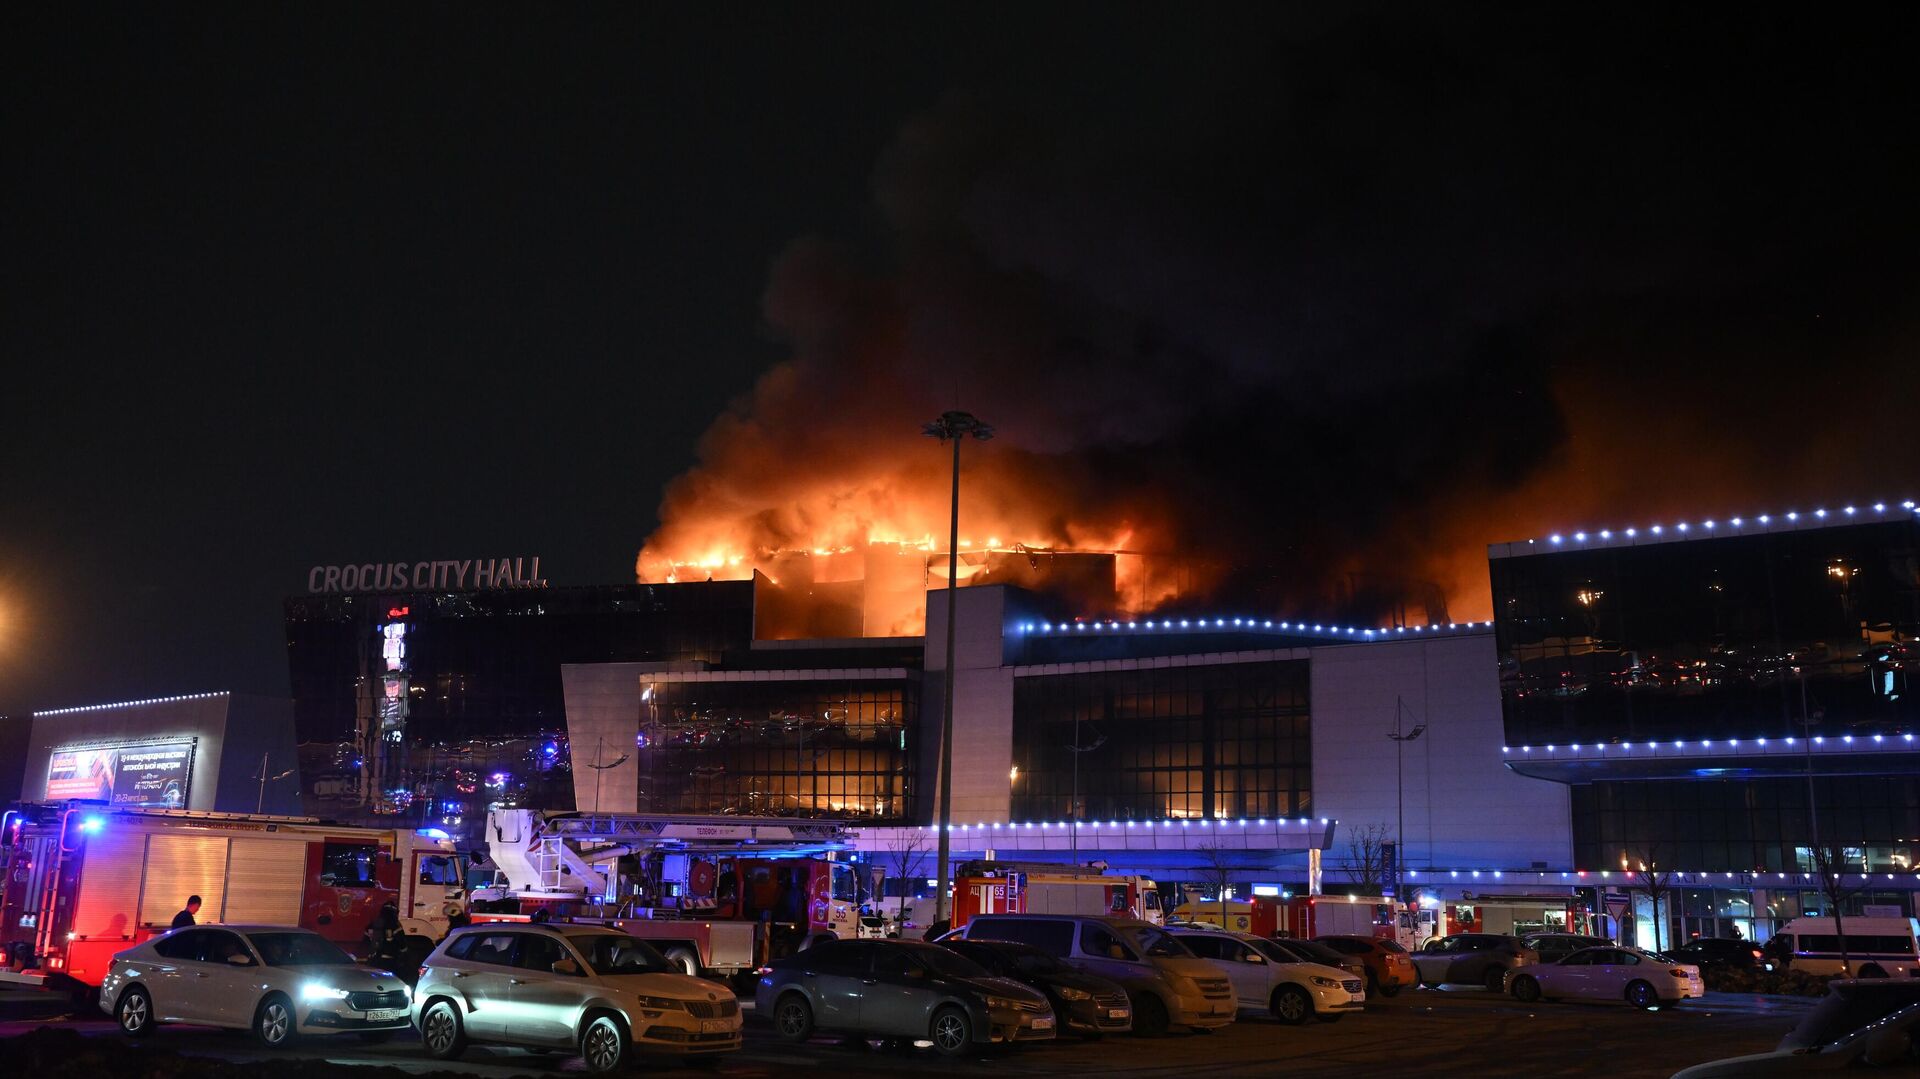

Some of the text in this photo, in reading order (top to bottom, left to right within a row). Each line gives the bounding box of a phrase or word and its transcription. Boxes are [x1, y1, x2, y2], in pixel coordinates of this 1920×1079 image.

[308, 556, 548, 593] CROCUS CITY HALL
[969, 886, 1004, 897] АЦ 65
[836, 908, 847, 919] 55
